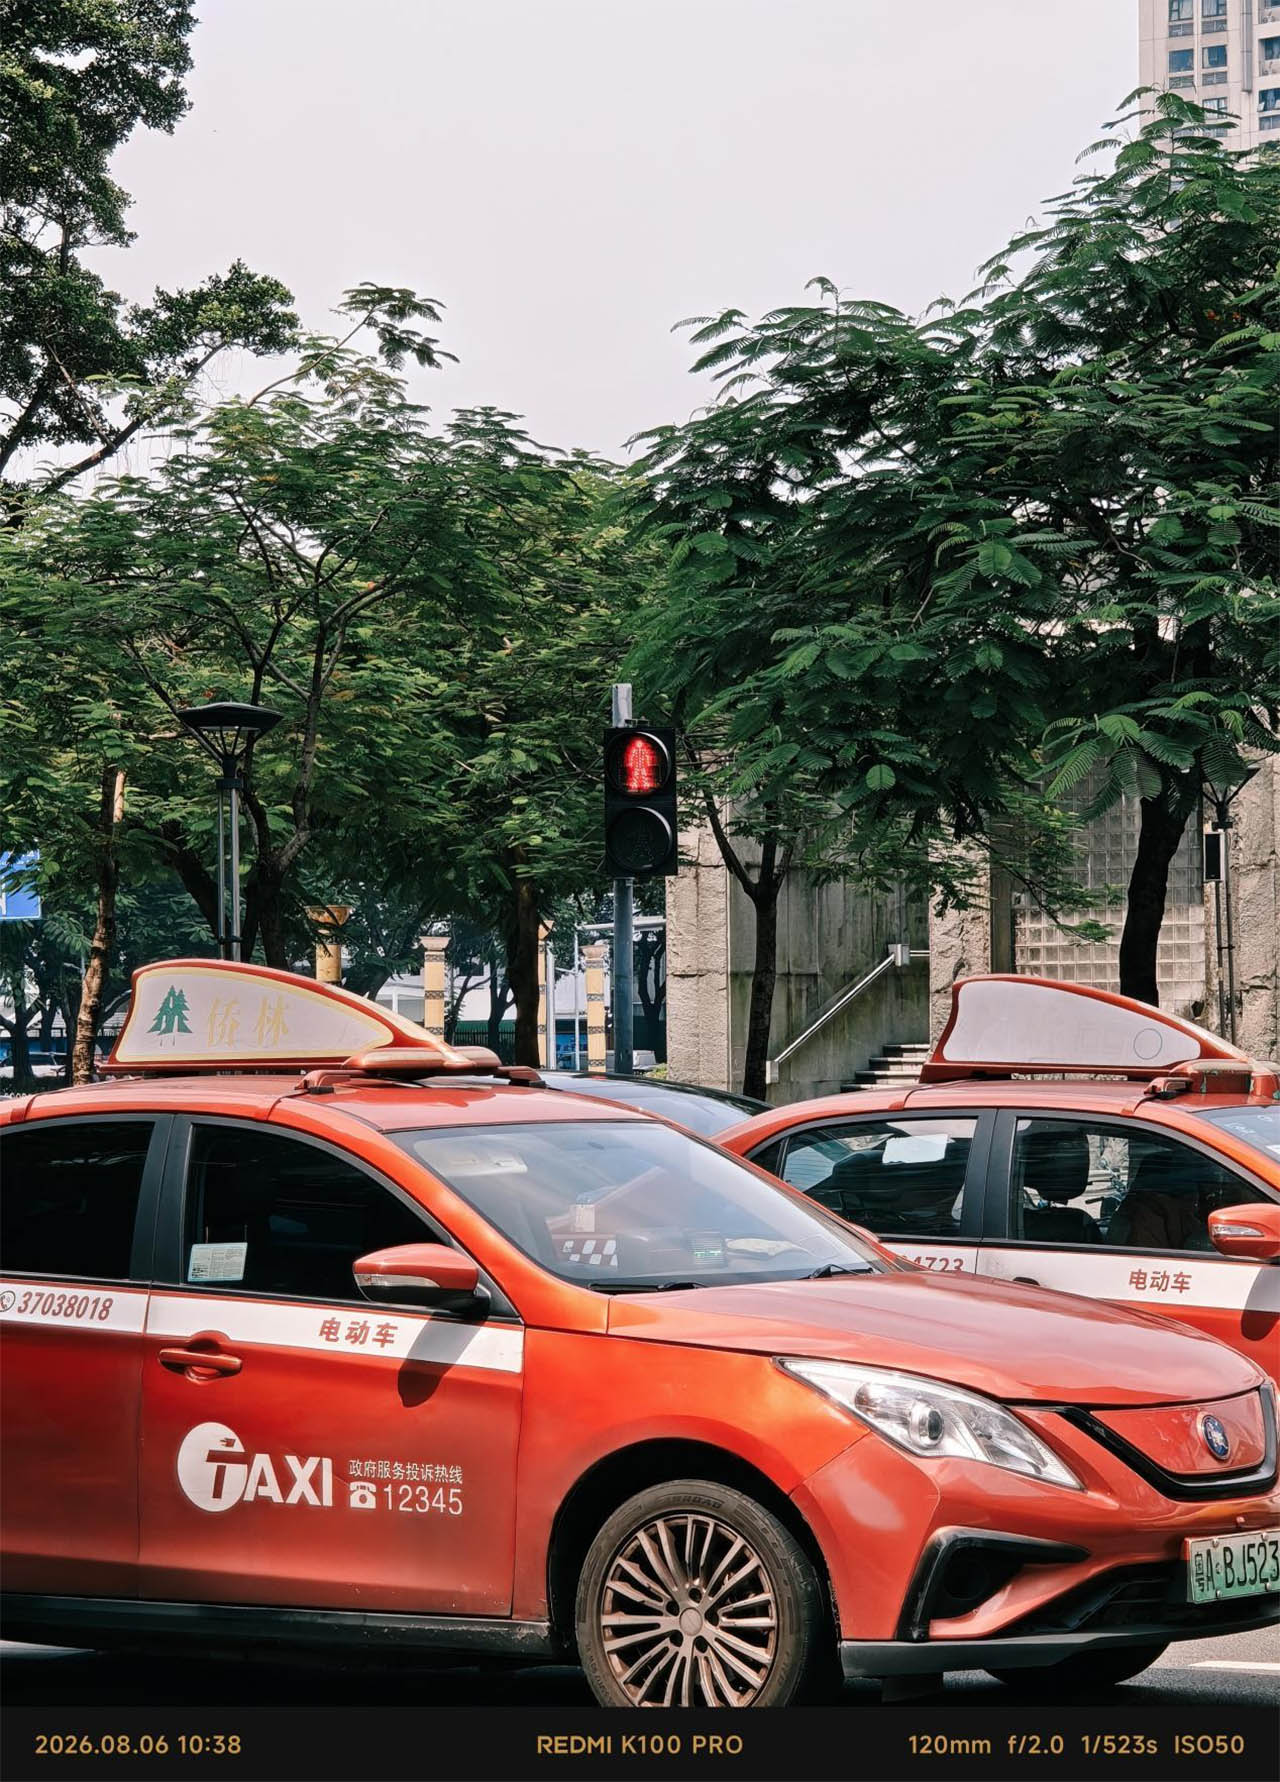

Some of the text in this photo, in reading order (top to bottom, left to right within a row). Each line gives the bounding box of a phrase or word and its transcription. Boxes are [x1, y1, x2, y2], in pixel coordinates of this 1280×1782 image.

[1128, 1268, 1192, 1294] 电动车
[17, 1291, 114, 1321] 37038018
[318, 1316, 398, 1348] 电动车
[205, 1448, 333, 1507] TAXI
[348, 1458, 463, 1484] 政府服务投诉热线
[383, 1483, 463, 1515] 12345
